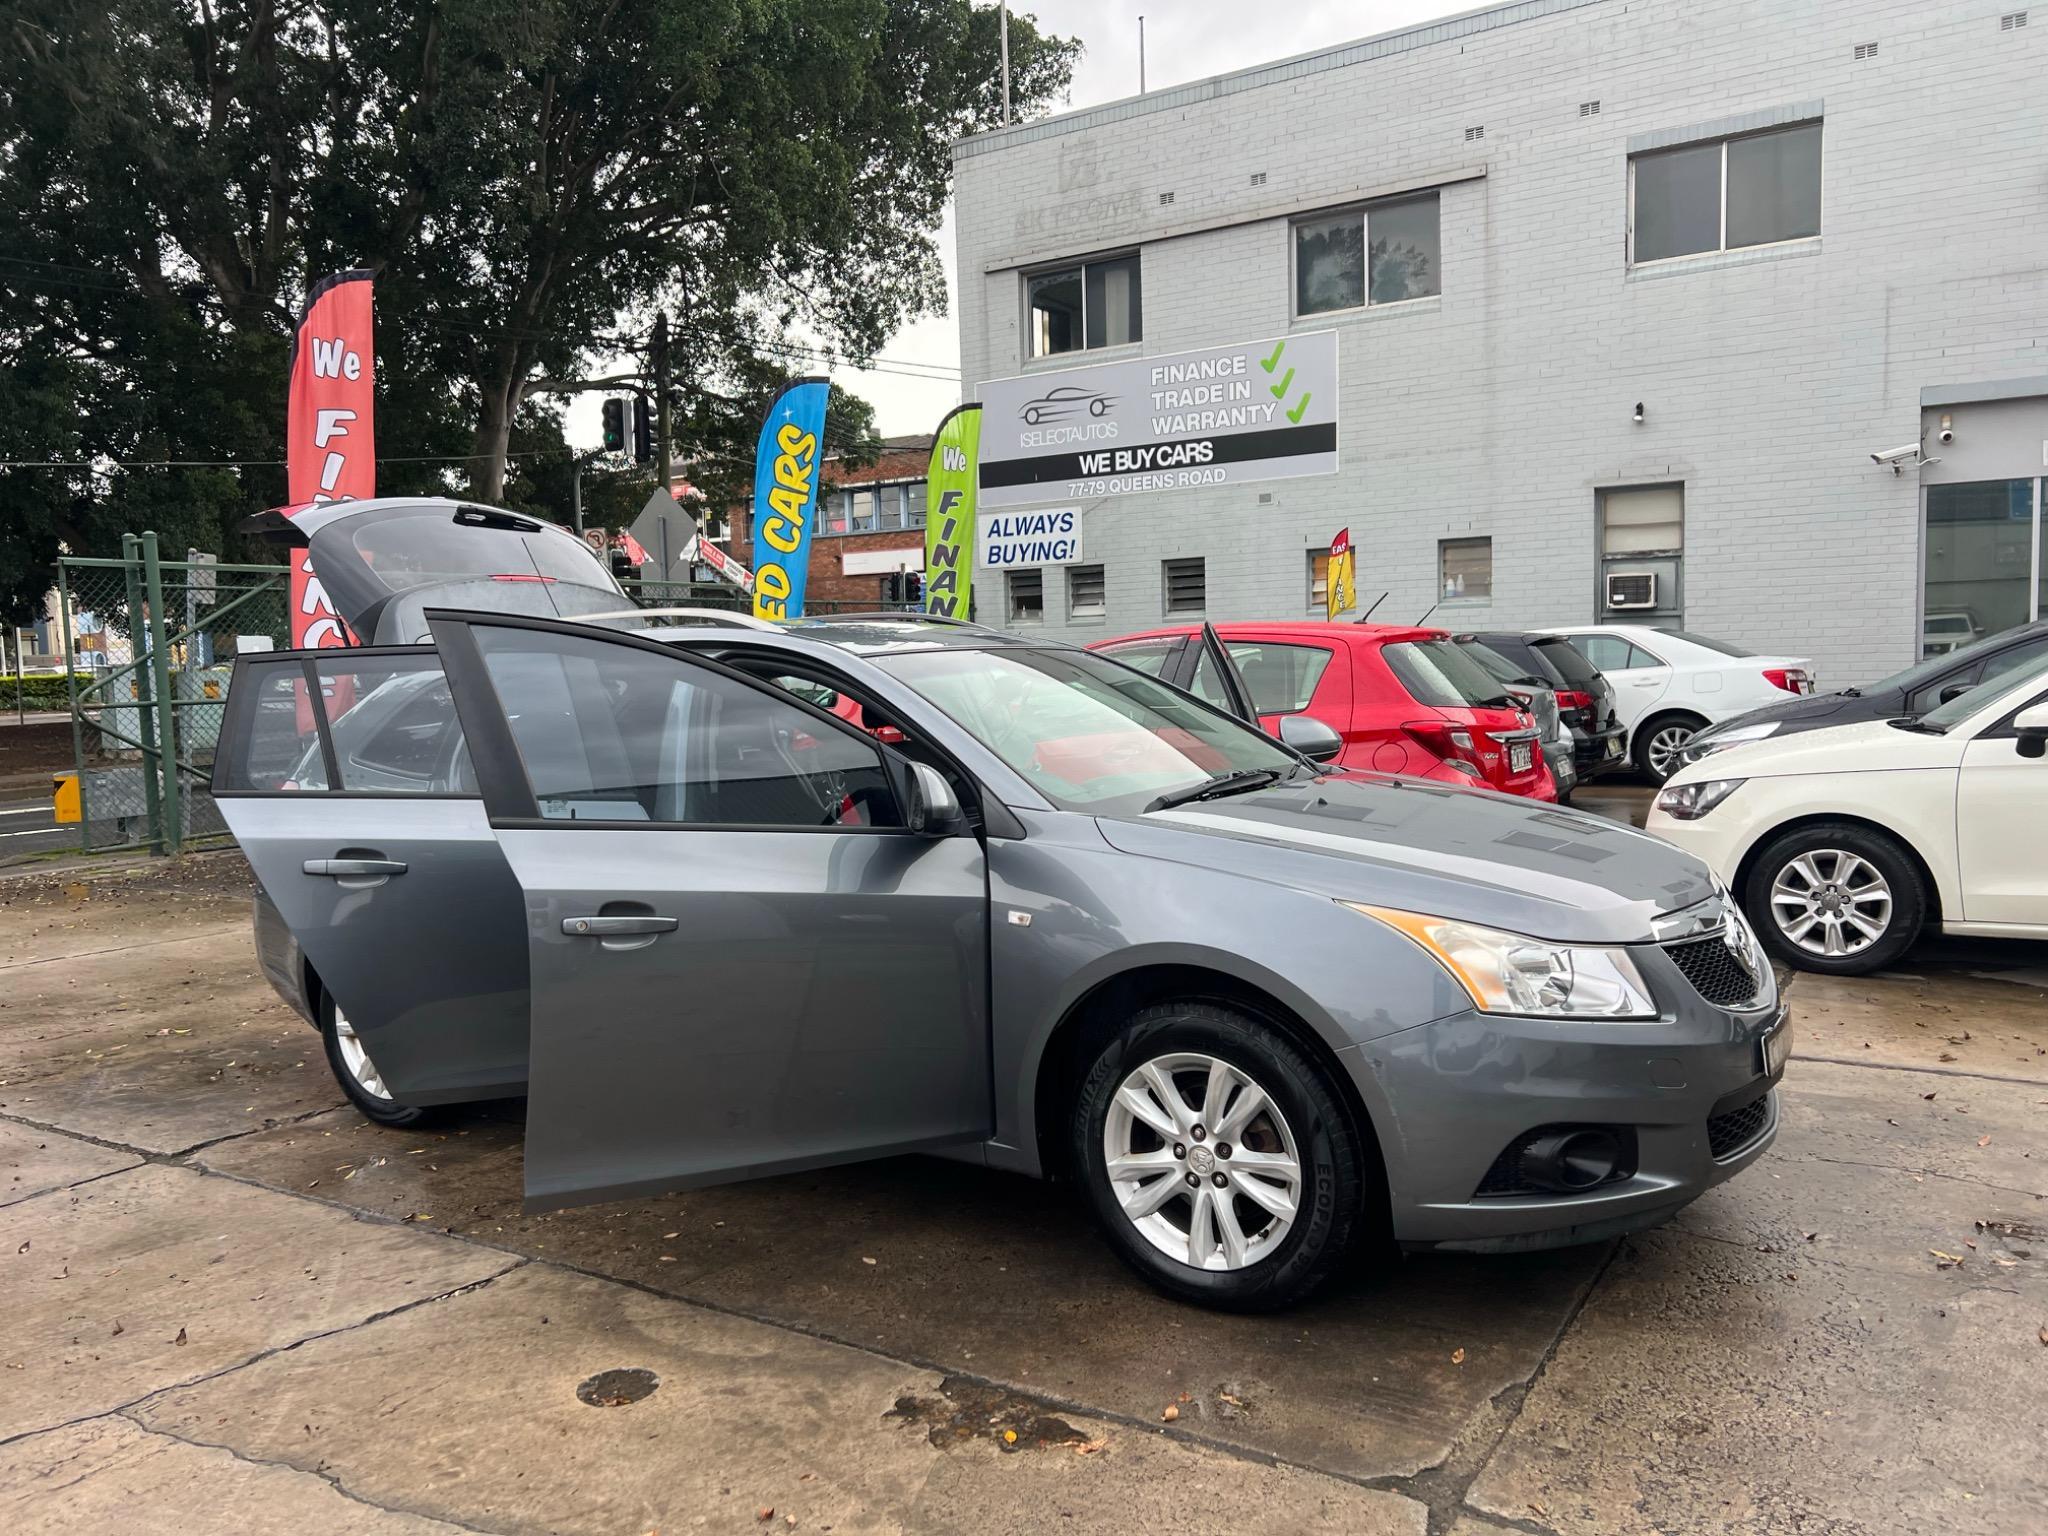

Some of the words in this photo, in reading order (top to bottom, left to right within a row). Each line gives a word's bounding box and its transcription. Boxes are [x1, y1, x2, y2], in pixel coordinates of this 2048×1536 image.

[312, 337, 362, 382] We
[1151, 355, 1247, 386] FINANCE
[1151, 385, 1223, 411] TRADE
[1228, 380, 1251, 400] IN
[1151, 402, 1277, 436] WARRANTY
[943, 445, 967, 472] We
[1079, 451, 1111, 475] WE
[1115, 447, 1155, 471] BUY
[1156, 441, 1213, 467] CARS
[762, 422, 817, 554] CARS
[1067, 480, 1106, 497] 77-79
[1109, 473, 1175, 494] QUEENS
[1178, 468, 1226, 487] ROAD
[987, 512, 1074, 538] ALWAYS
[929, 491, 964, 619] FINAN
[987, 540, 1076, 564] BUYING!
[1332, 542, 1346, 554] EAS
